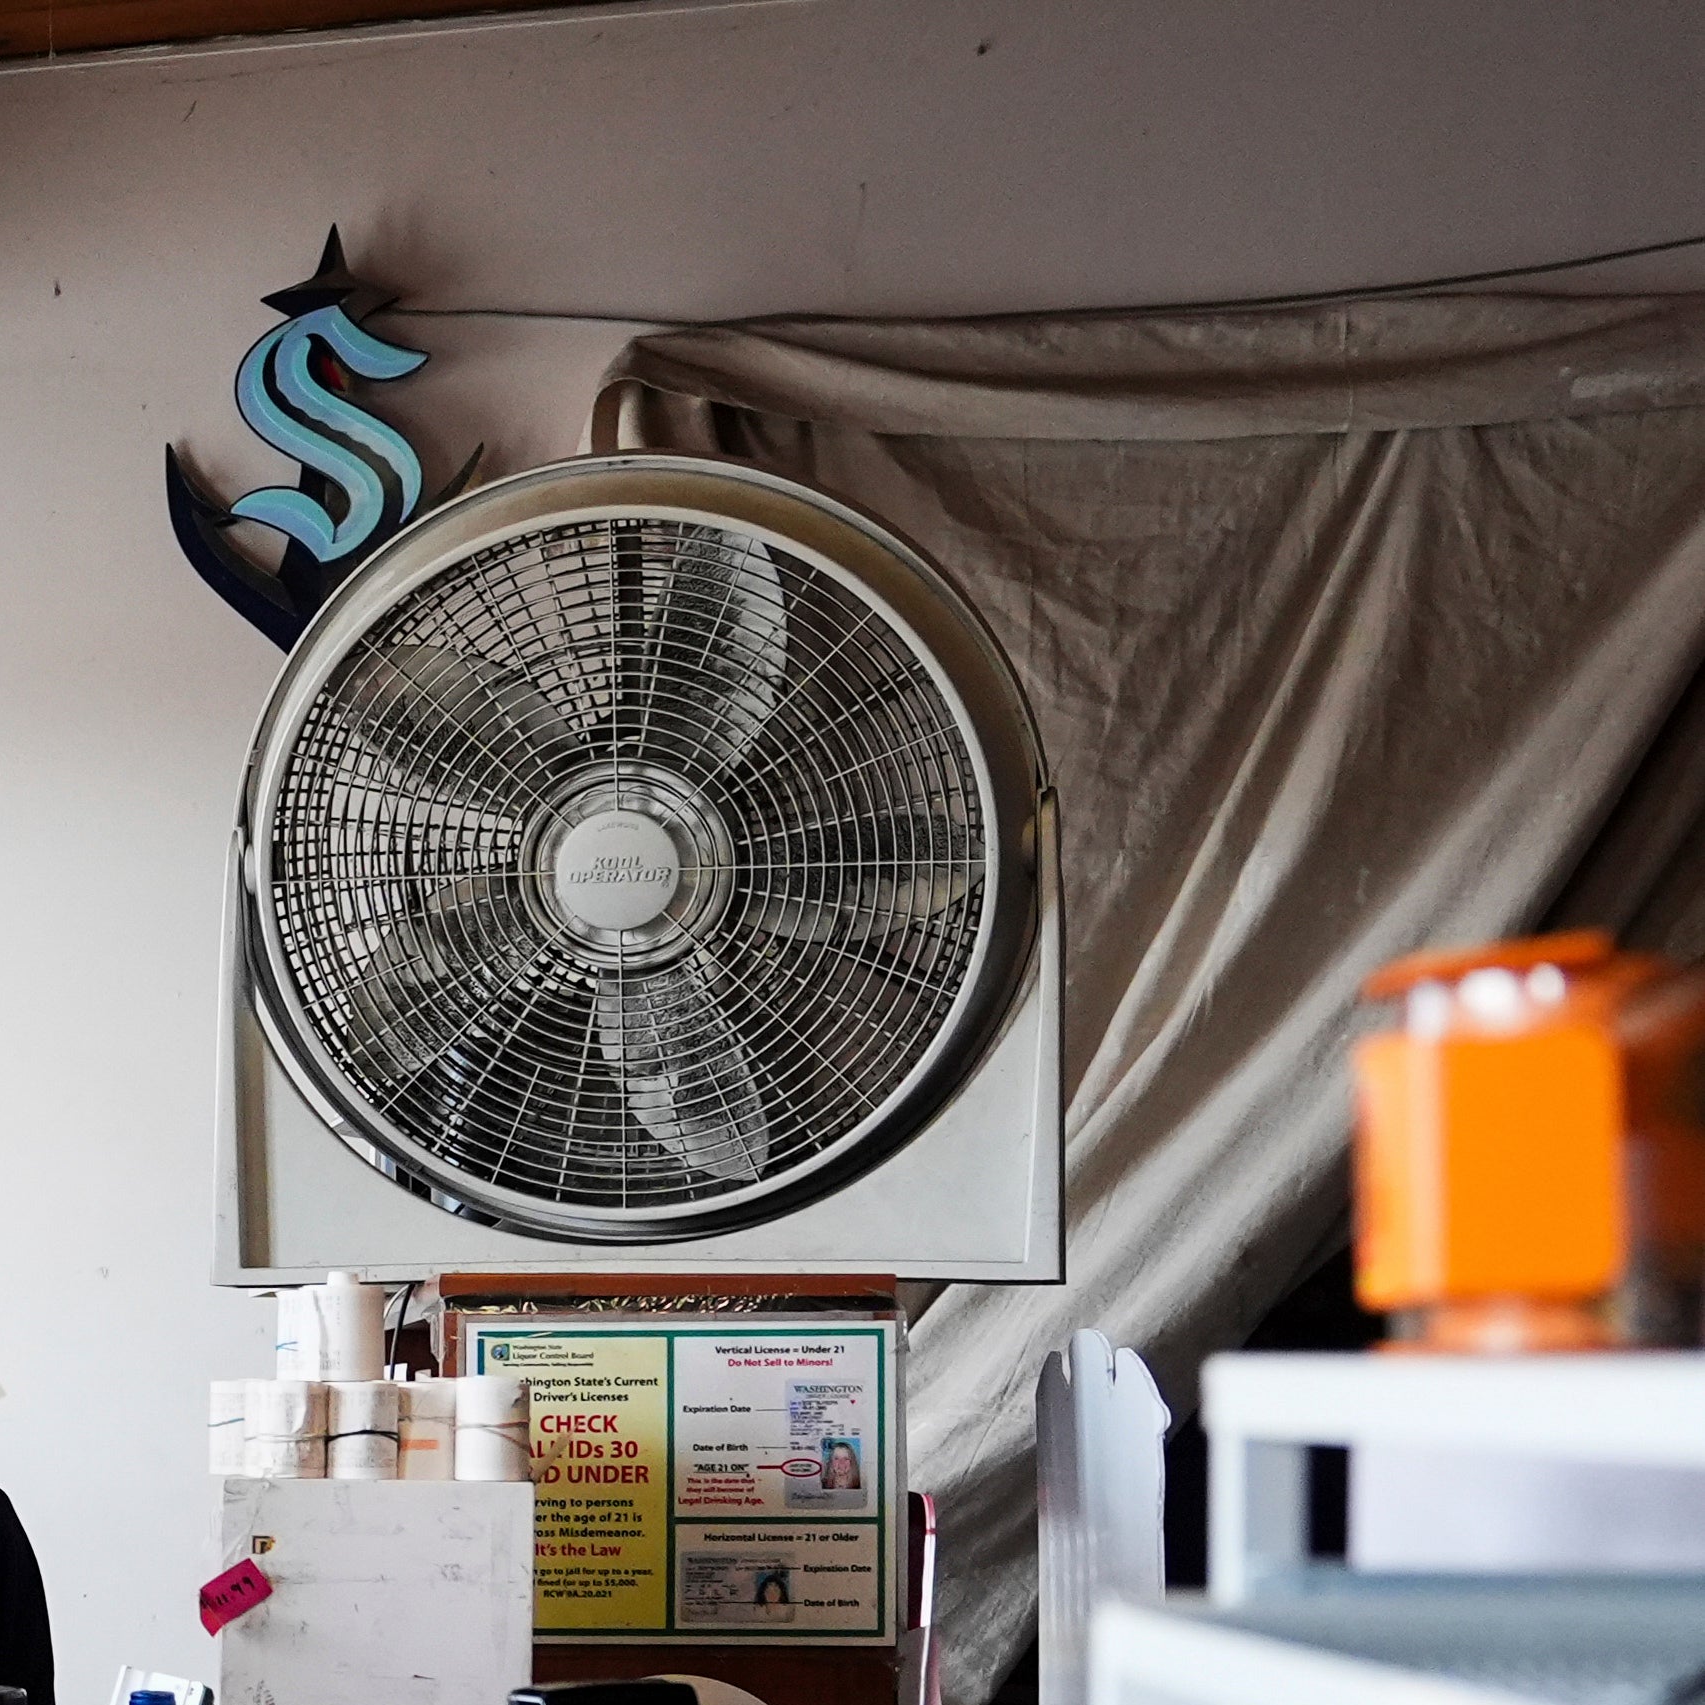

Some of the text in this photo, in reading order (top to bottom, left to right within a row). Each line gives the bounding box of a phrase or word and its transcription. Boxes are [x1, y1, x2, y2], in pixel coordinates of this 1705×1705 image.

[593, 856, 644, 869] KOOL
[570, 866, 672, 884] OPERATOR
[715, 1346, 752, 1354] Vertical
[754, 1346, 790, 1354] License
[801, 1346, 831, 1354] Under
[834, 1346, 845, 1354] 21
[512, 1352, 595, 1360] Liquor Control Board
[728, 1359, 741, 1367] Do
[744, 1359, 762, 1367] Not
[764, 1359, 782, 1367] Sell
[796, 1359, 833, 1367] Minors!
[521, 1377, 658, 1387] hington State's Current
[794, 1384, 863, 1393] WASHINGTON
[534, 1392, 629, 1401] Driver's Licenses
[683, 1405, 728, 1413] Expiration
[540, 1415, 618, 1433] CHECK
[569, 1441, 604, 1458] IDs
[610, 1441, 638, 1459] 30
[714, 1443, 725, 1451] of
[726, 1443, 748, 1451] Birth
[718, 1464, 728, 1472] 21
[568, 1465, 649, 1484] UNDER
[535, 1497, 633, 1509] rving to persons
[678, 1497, 702, 1505] Legal
[704, 1497, 742, 1506] Drinking
[551, 1513, 570, 1522] the
[573, 1514, 596, 1524] age
[599, 1512, 611, 1522] of
[615, 1513, 628, 1522] 21
[633, 1513, 642, 1522] is
[559, 1528, 645, 1538] Misdemeanor.
[704, 1533, 755, 1542] Horizontal
[758, 1533, 794, 1542] License
[805, 1534, 816, 1542] 21
[832, 1533, 859, 1542] Older
[561, 1543, 586, 1556] the
[591, 1544, 621, 1556] Law
[565, 1567, 580, 1576] jail
[582, 1567, 595, 1575] for
[803, 1564, 871, 1573] Expiration Date
[804, 1599, 859, 1607] Date of Birth
